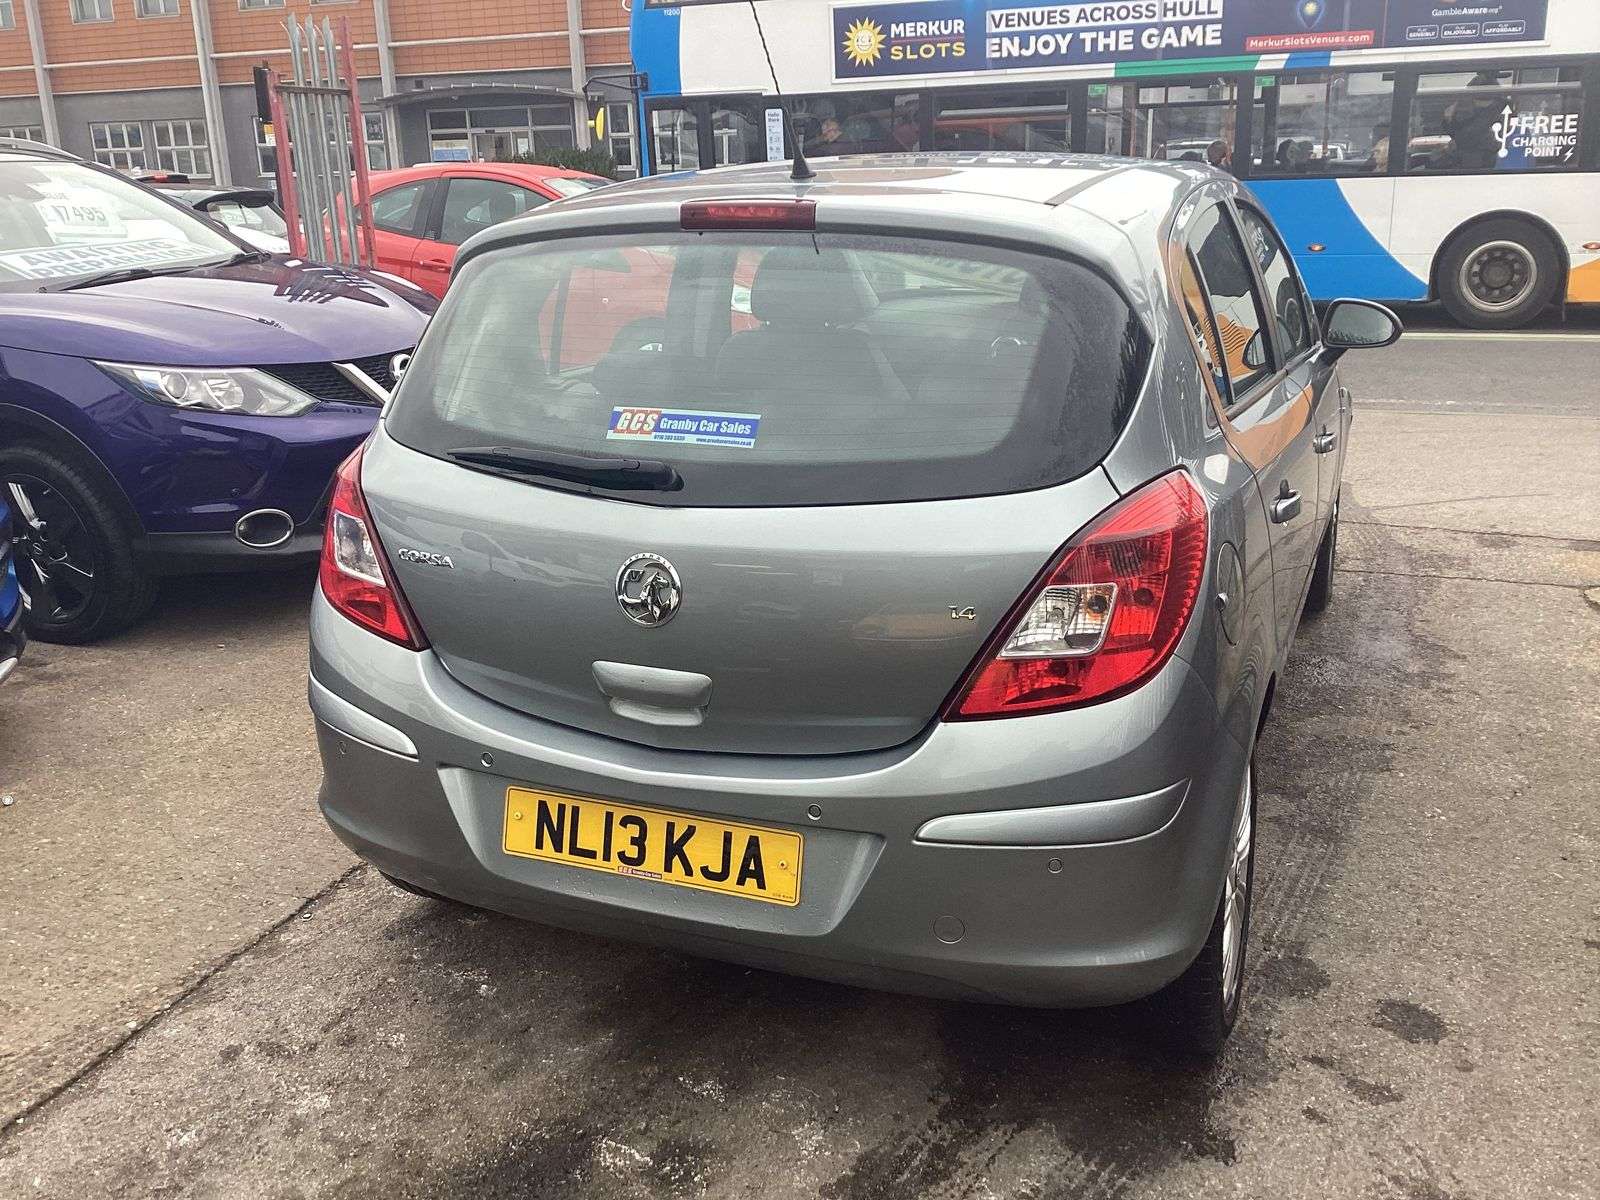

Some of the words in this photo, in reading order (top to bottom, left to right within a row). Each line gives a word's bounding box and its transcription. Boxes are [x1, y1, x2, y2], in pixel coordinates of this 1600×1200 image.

[991, 10, 1070, 29] VENUES
[1075, 3, 1157, 24] ACROSS
[1163, 0, 1218, 18] HULL
[890, 19, 965, 38] MERKUR
[891, 42, 966, 60] SLOTS
[986, 33, 1074, 58] ENJOY
[1079, 29, 1134, 53] THE
[1141, 24, 1223, 49] GAME
[1250, 34, 1370, 48] MerkurSlotsVenues.com
[1519, 114, 1578, 135] FREE
[1512, 135, 1577, 147] CHARGING
[1524, 146, 1562, 157] POINT
[20, 240, 177, 266] AWAITING
[616, 411, 659, 432] GCS
[659, 417, 698, 432] Granby
[700, 420, 719, 432] Car
[720, 421, 752, 435] Sales
[398, 548, 455, 569] CORSA
[535, 800, 648, 868] NL13
[663, 821, 767, 891] KJA
